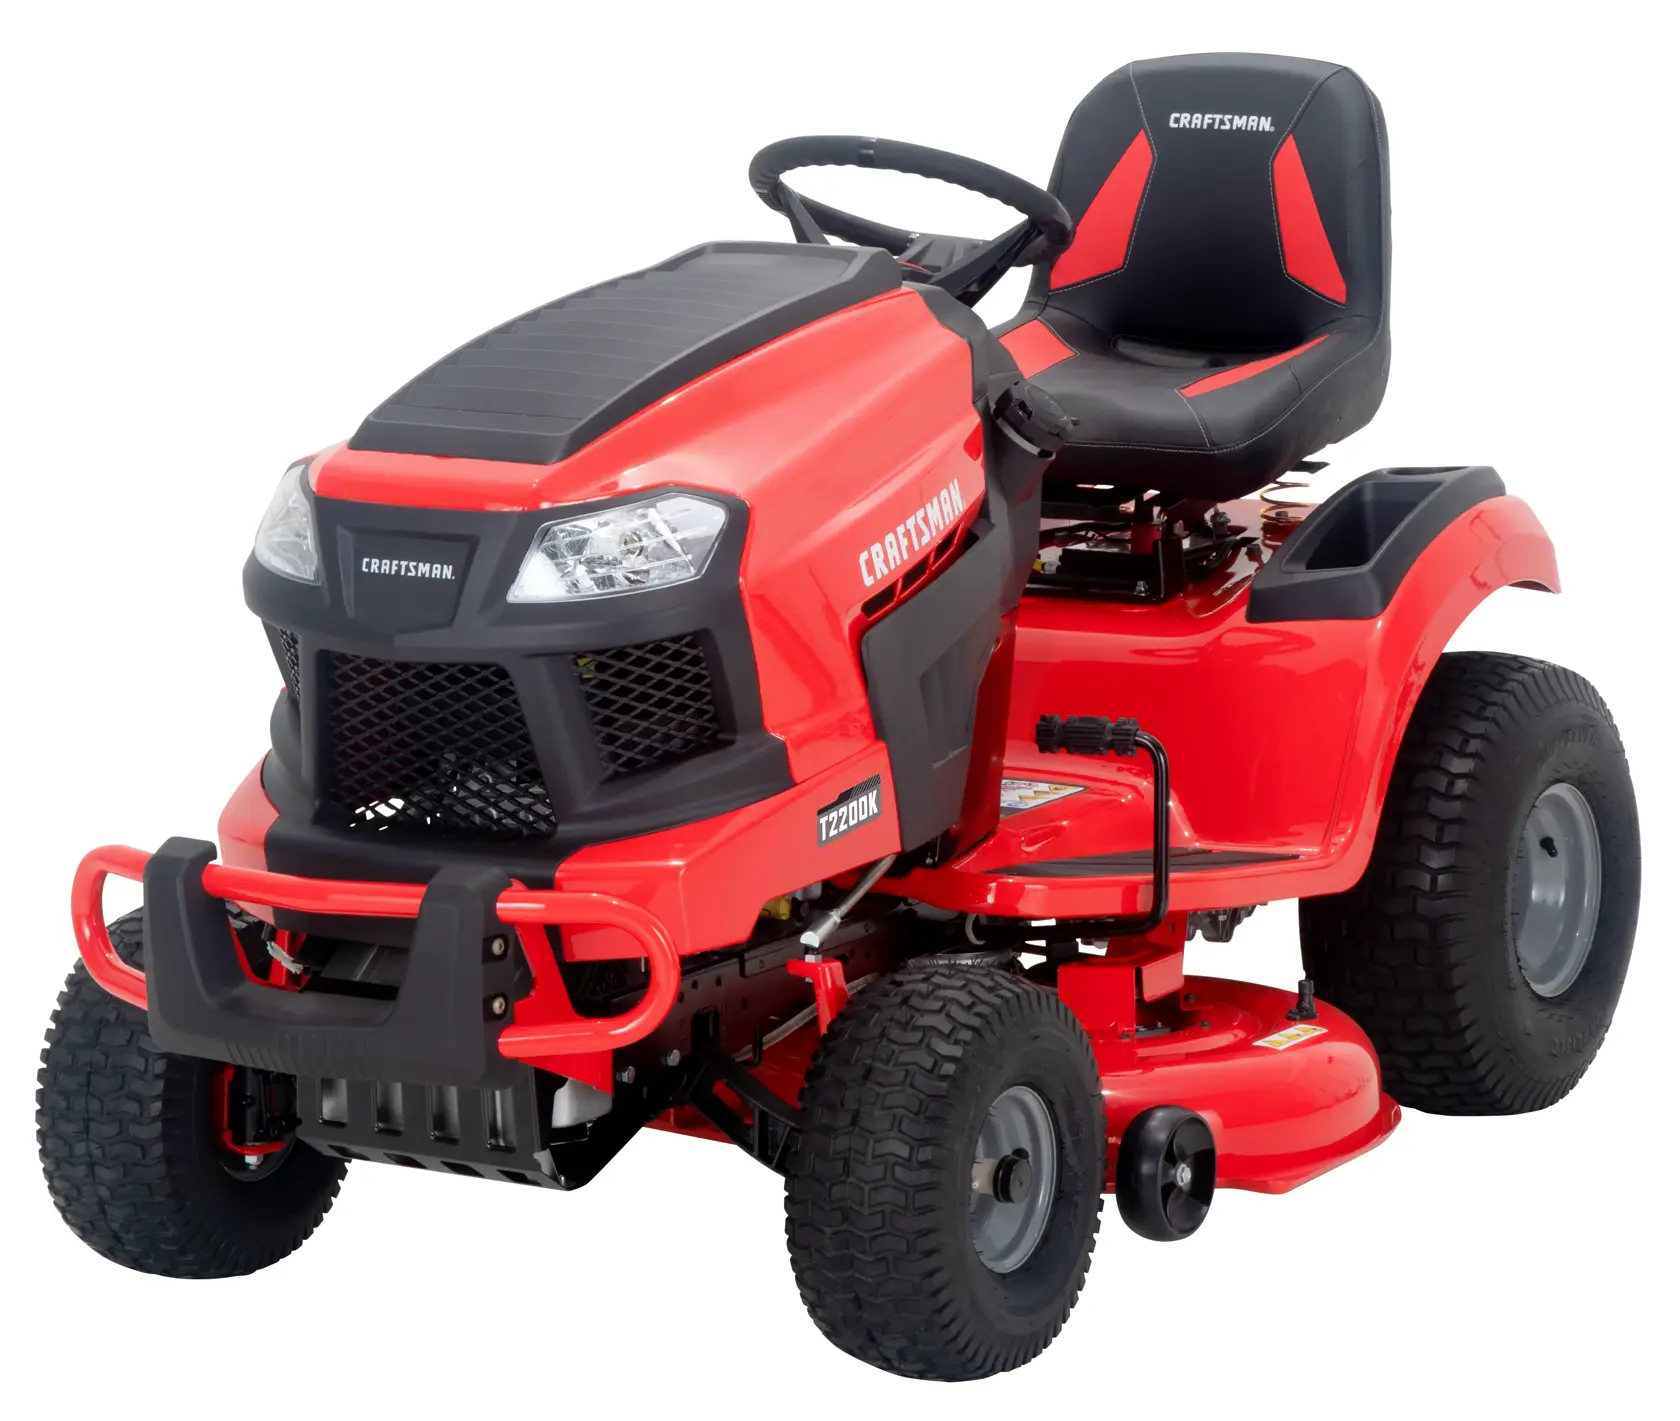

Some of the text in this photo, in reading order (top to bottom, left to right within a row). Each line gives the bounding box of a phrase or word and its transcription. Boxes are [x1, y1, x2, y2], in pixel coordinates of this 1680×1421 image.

[1168, 113, 1272, 132] CRAFTSMAN
[859, 478, 964, 587] CRAFTSMAN
[819, 789, 878, 841] T2200K
